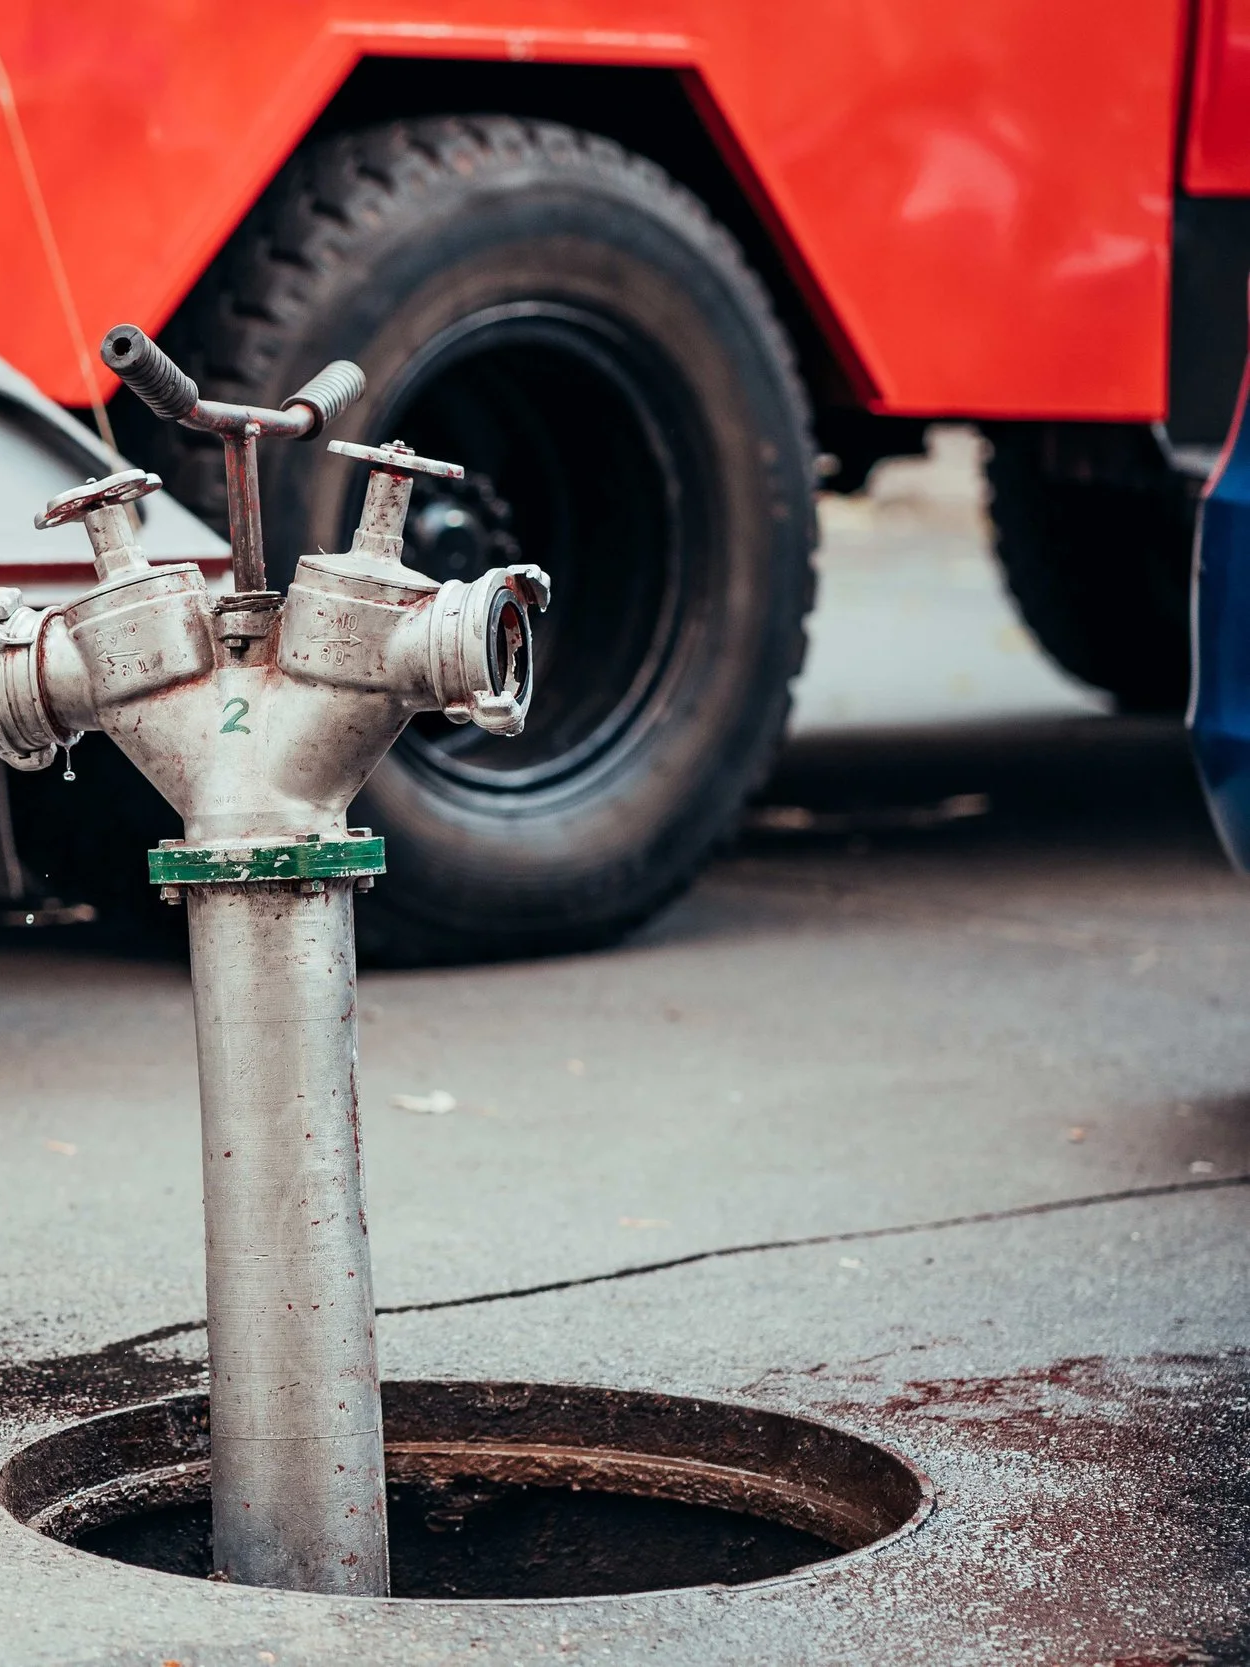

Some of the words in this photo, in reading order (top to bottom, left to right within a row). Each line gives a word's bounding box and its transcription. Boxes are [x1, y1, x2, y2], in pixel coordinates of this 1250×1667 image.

[120, 655, 147, 679] 80
[320, 646, 345, 666] 80
[219, 696, 251, 735] 2
